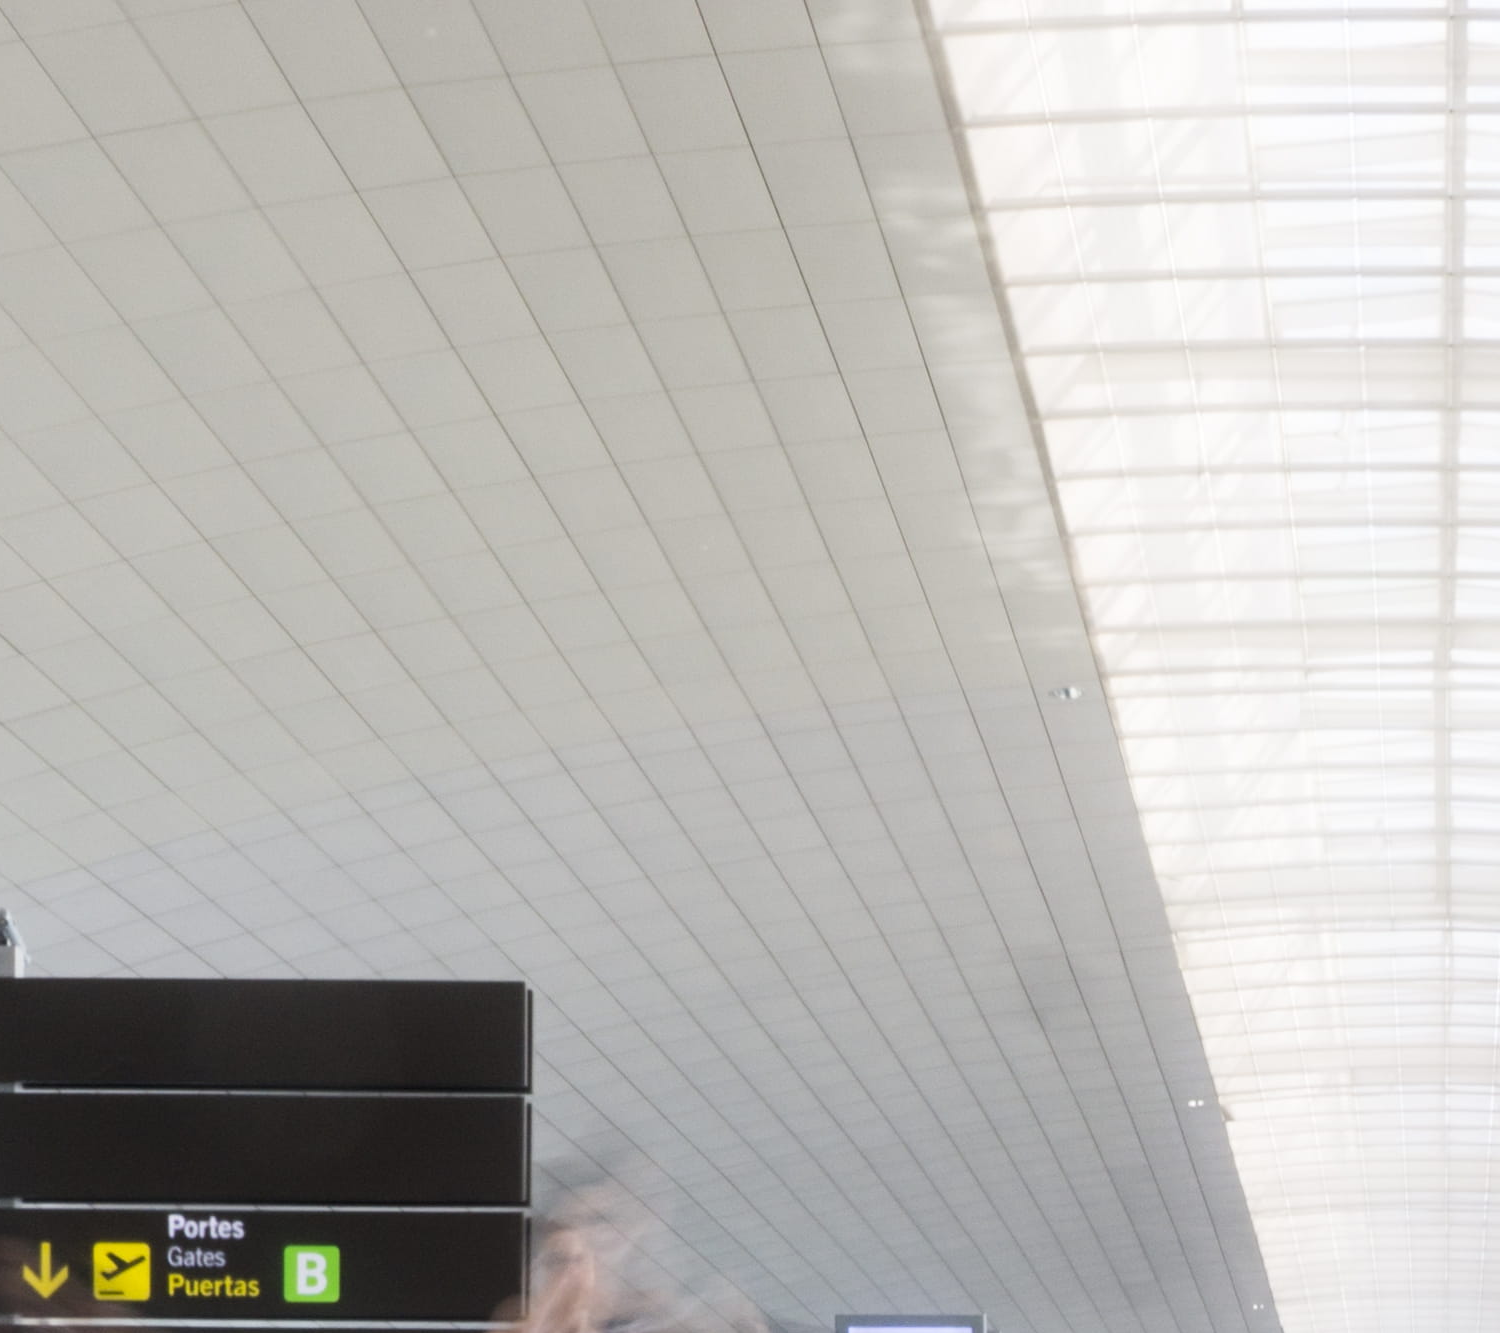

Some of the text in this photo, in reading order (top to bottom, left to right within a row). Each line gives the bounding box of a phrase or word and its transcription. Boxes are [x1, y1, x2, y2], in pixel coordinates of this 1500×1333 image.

[167, 1213, 245, 1240] Portes
[167, 1245, 226, 1268] Gates
[168, 1273, 260, 1298] Puertas
[296, 1251, 328, 1296] B
